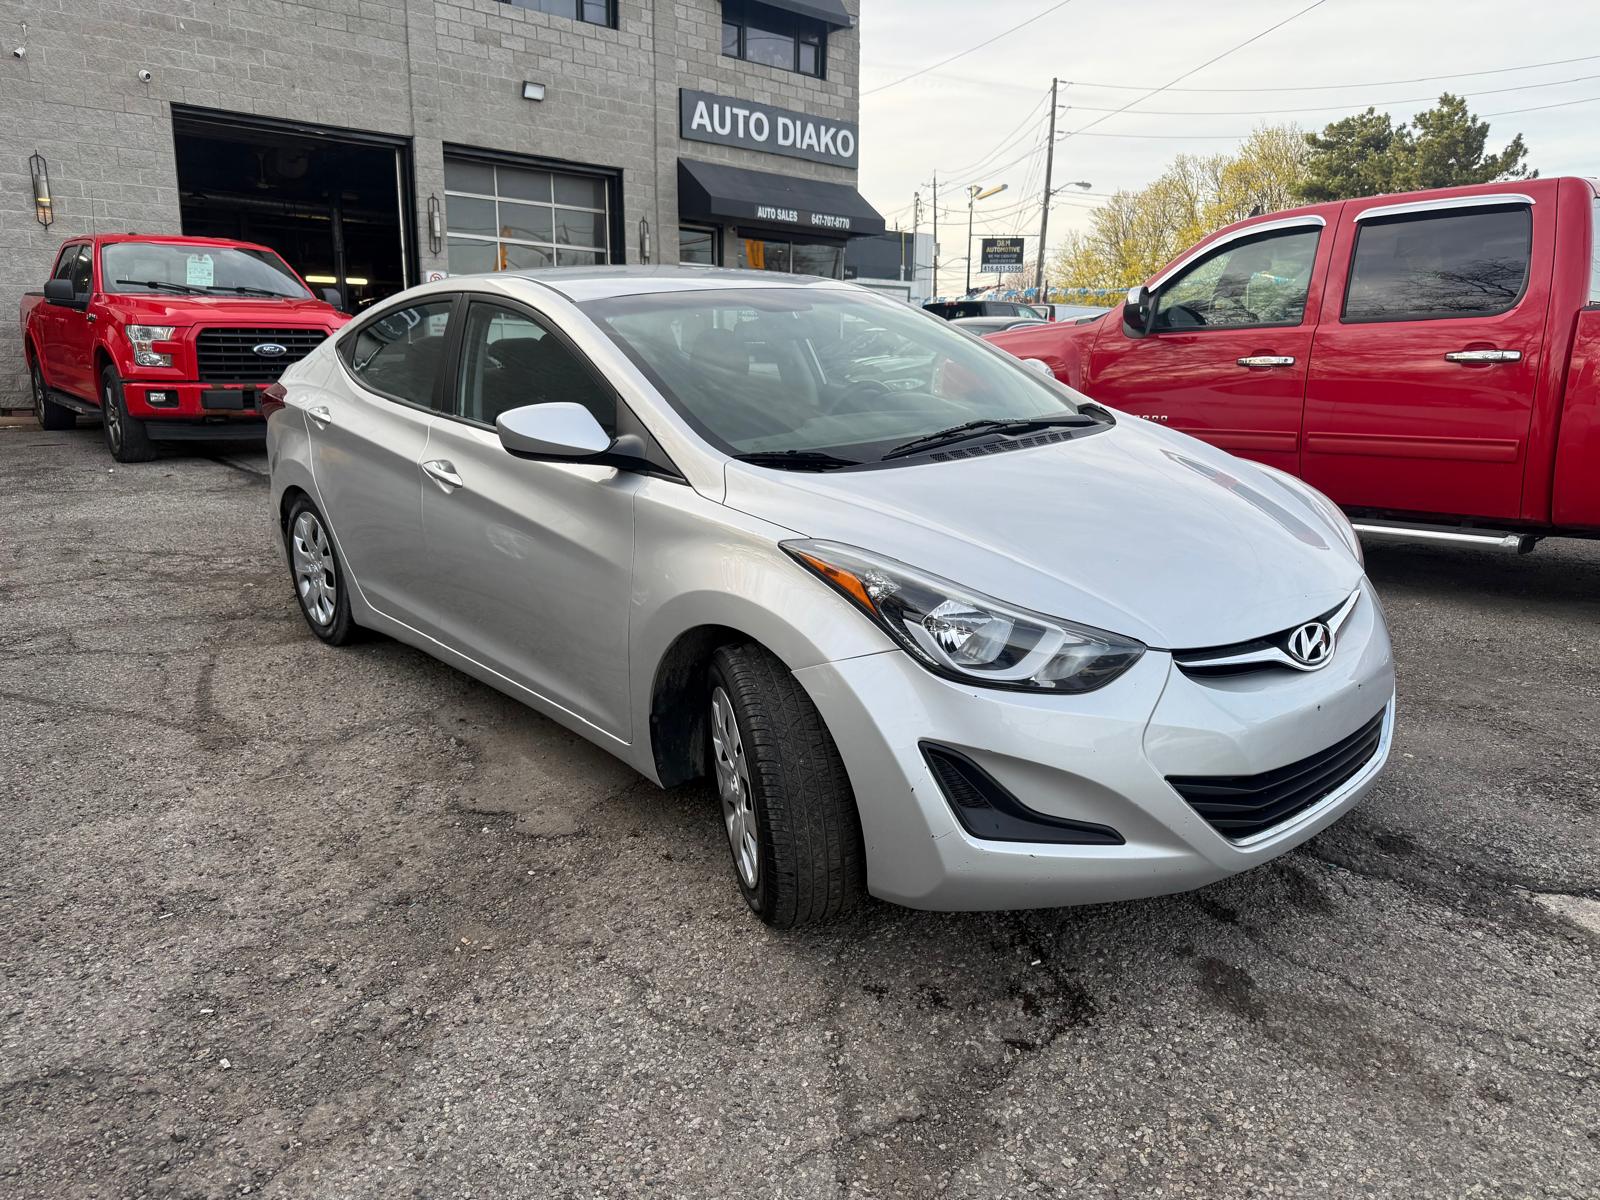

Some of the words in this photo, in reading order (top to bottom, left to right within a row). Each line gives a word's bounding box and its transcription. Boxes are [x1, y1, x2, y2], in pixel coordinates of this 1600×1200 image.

[691, 101, 769, 142] AUTO
[777, 117, 855, 158] DIAKO
[757, 206, 776, 220] AUTO
[777, 209, 799, 223] SALES
[811, 213, 851, 230] 647-707-8770
[996, 239, 1011, 247] D&M
